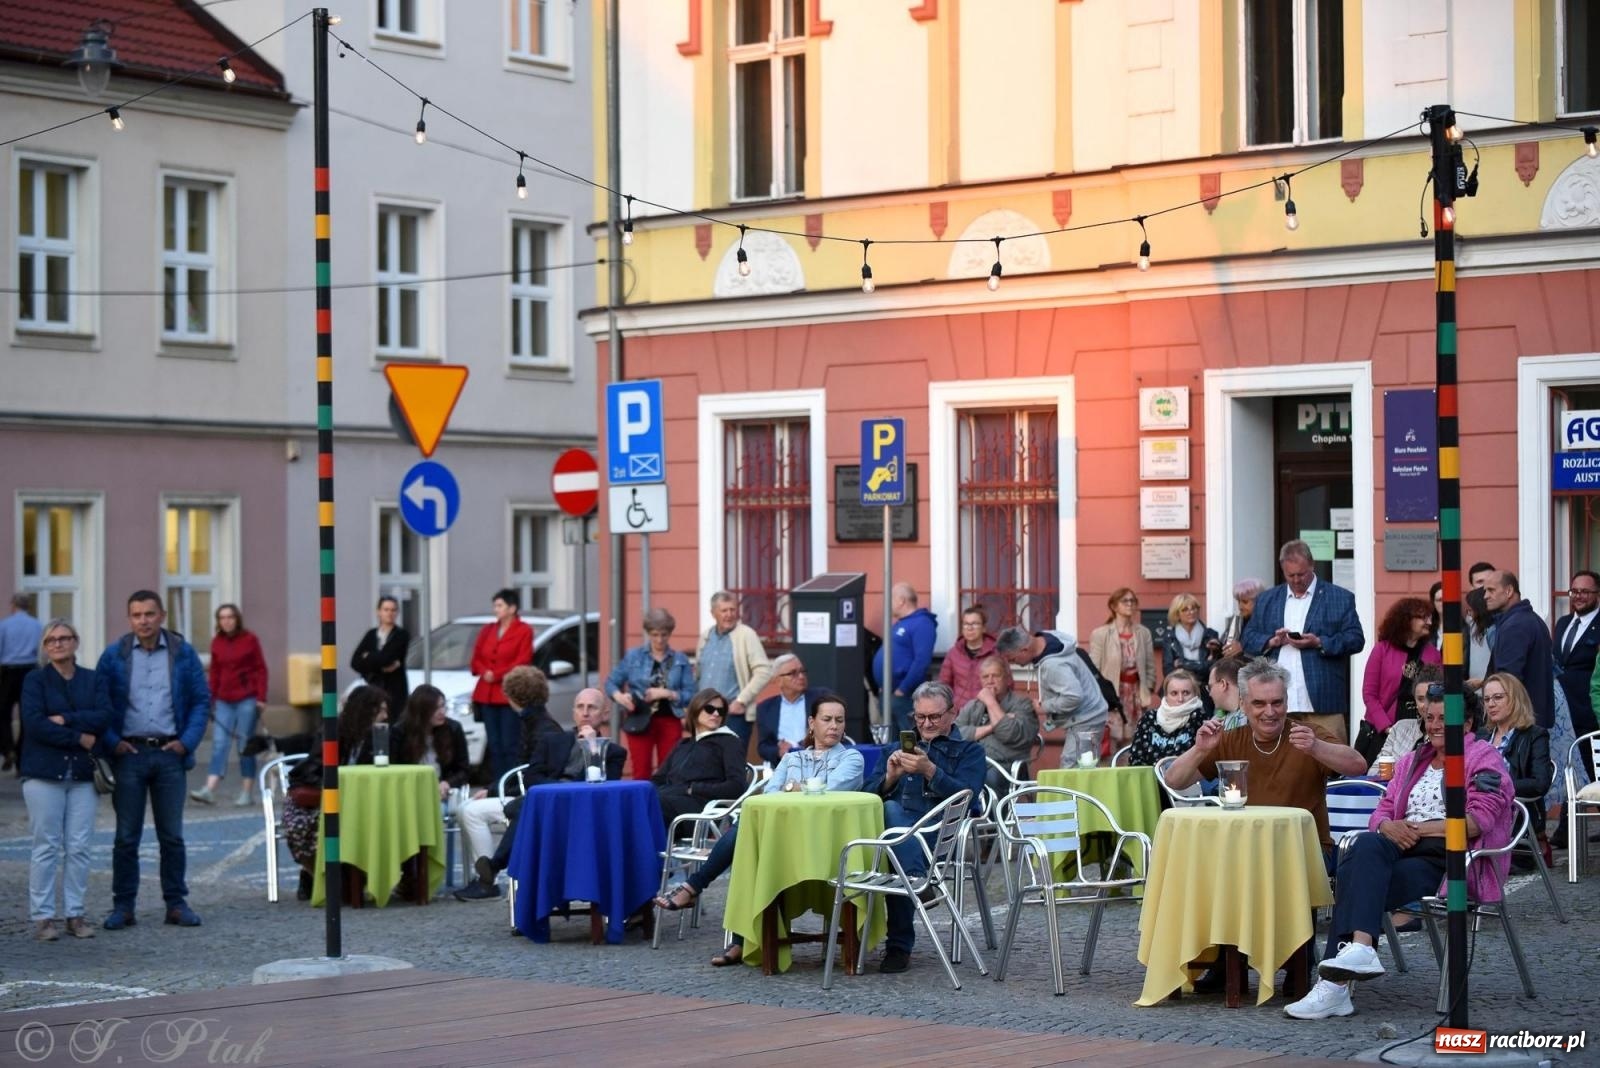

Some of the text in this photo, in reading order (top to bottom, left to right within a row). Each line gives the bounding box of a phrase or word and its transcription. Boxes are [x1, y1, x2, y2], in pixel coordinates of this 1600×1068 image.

[618, 390, 650, 453] P
[873, 423, 896, 460] P
[1311, 434, 1347, 444] Chopina
[863, 491, 901, 501] PARKOMAT
[843, 600, 853, 619] P
